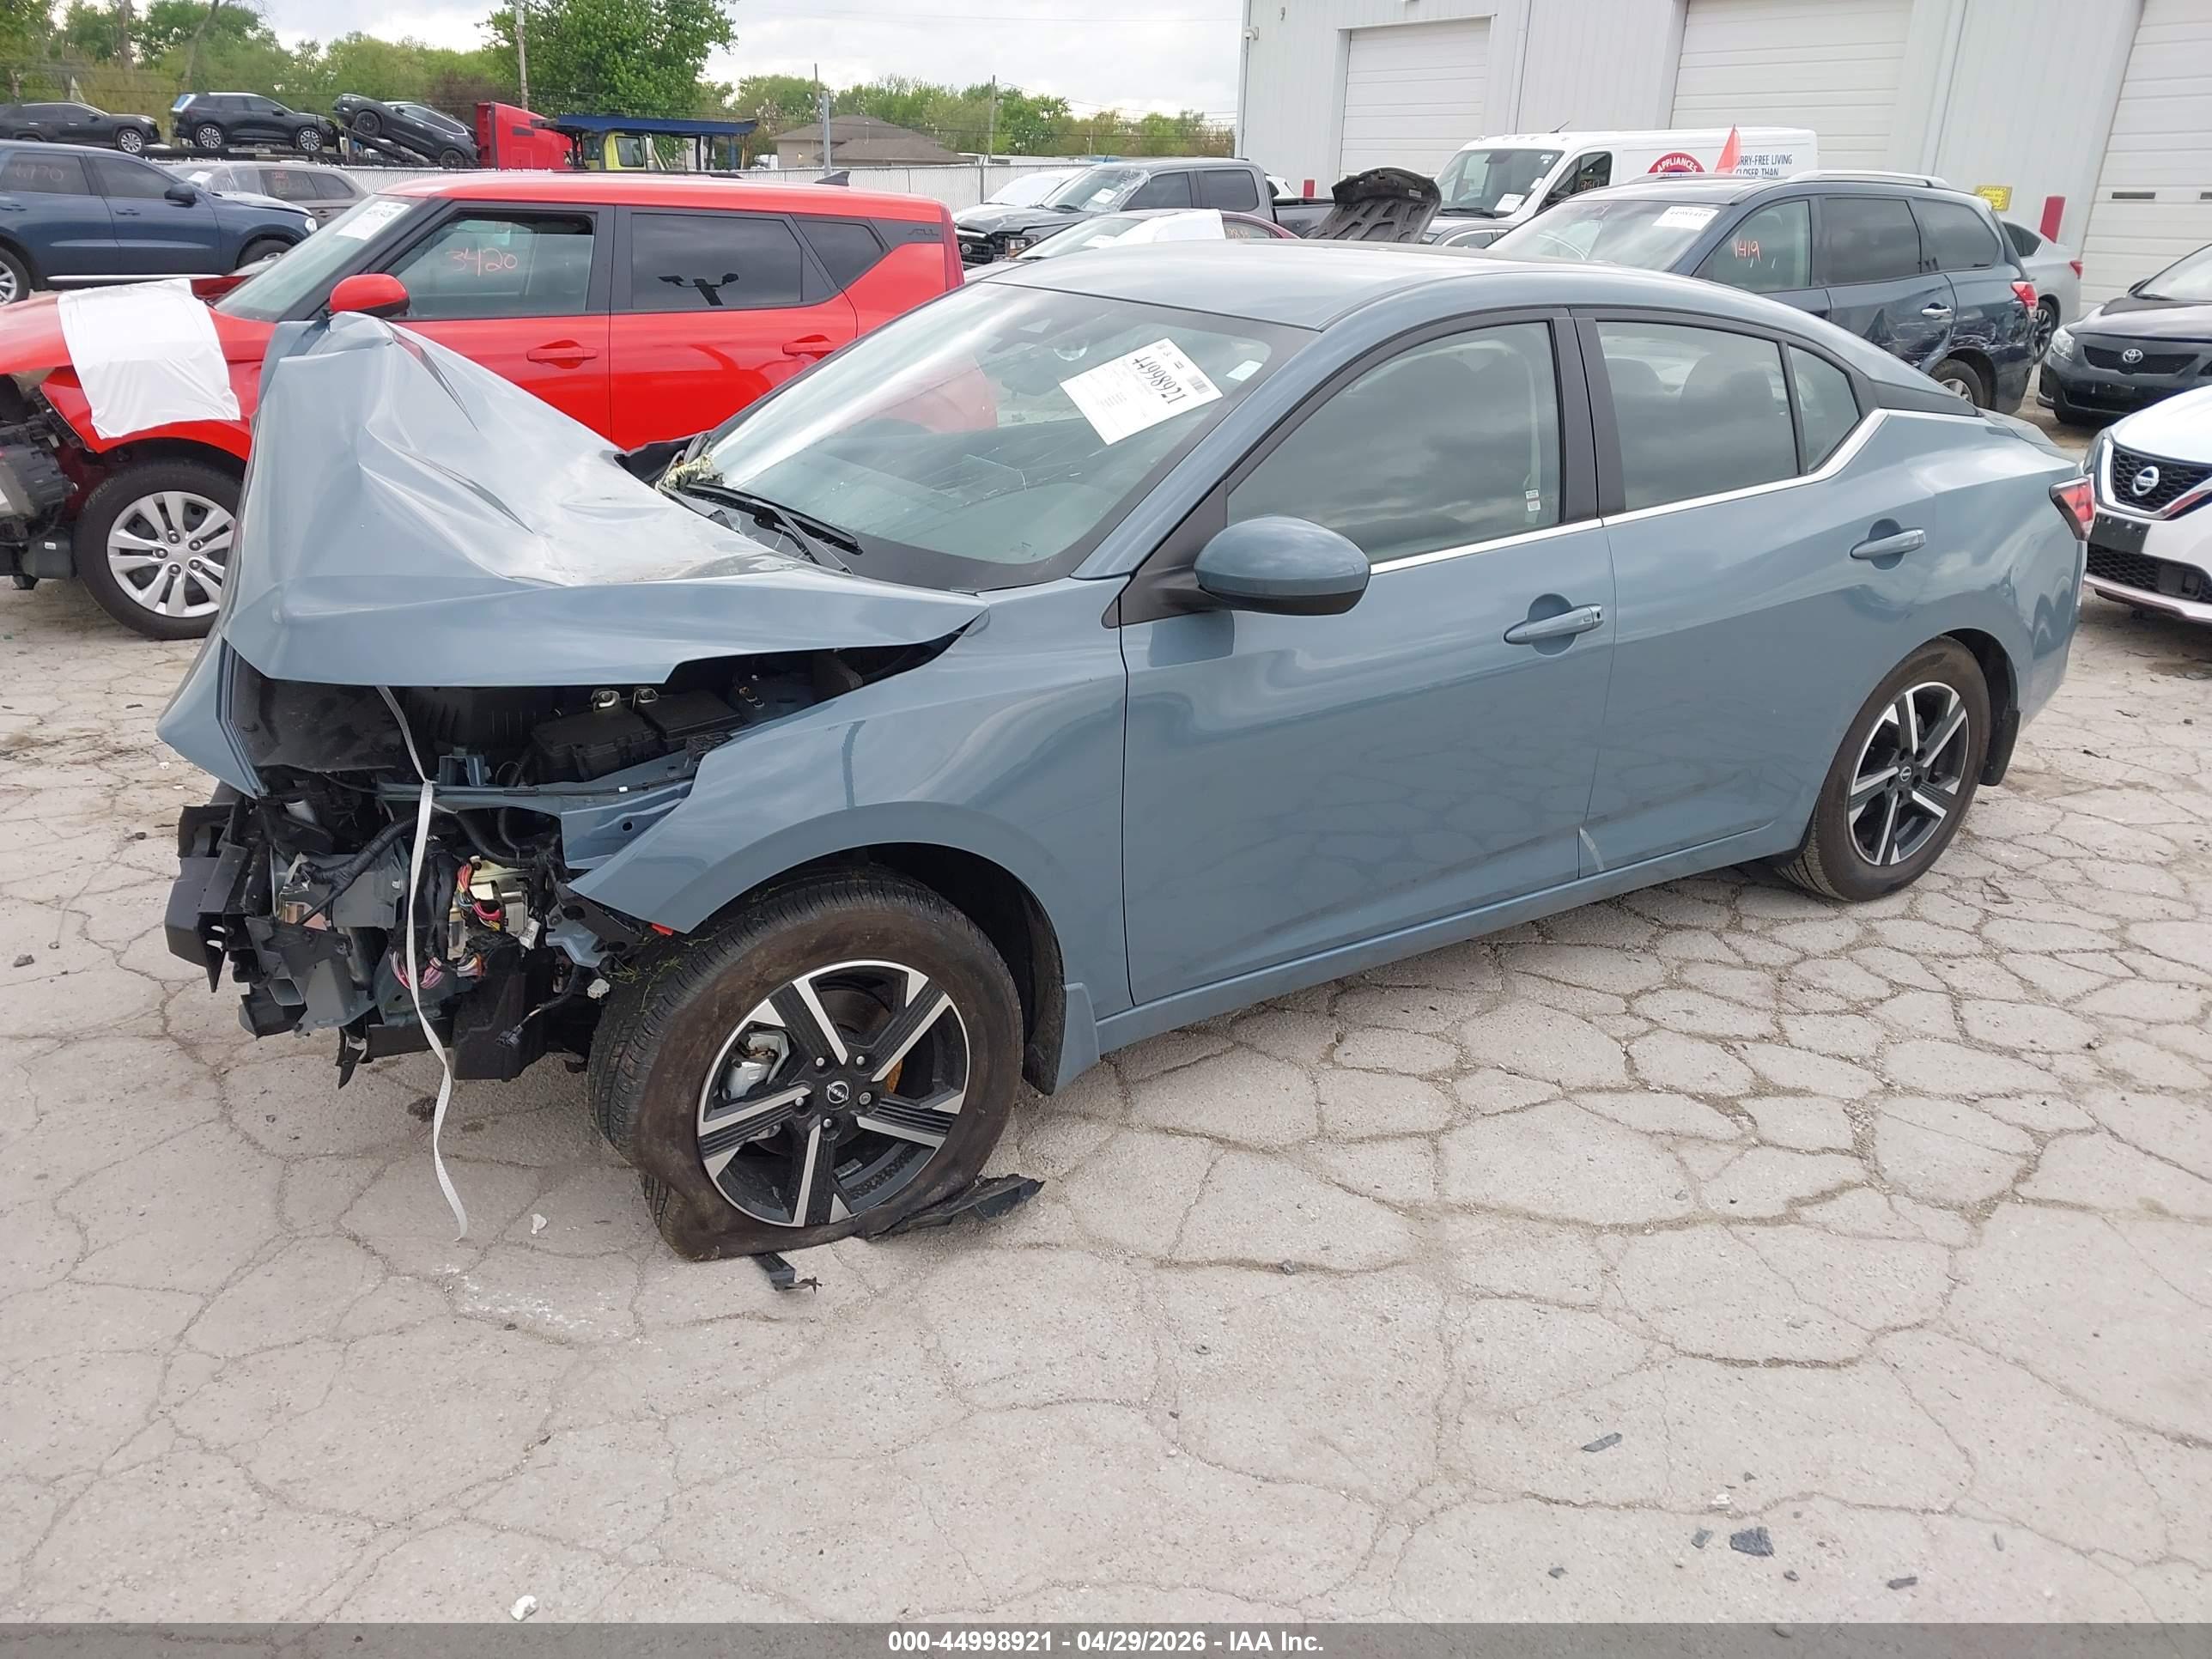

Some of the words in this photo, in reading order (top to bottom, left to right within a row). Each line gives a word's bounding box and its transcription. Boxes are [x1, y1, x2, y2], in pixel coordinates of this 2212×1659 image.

[1657, 156, 1698, 173] APPLIANCES
[1771, 154, 1793, 165] LIVING
[1761, 167, 1779, 176] THAN
[445, 247, 518, 276] 3420
[1132, 356, 1188, 404] 44998921
[826, 1085, 849, 1101] NISSAN
